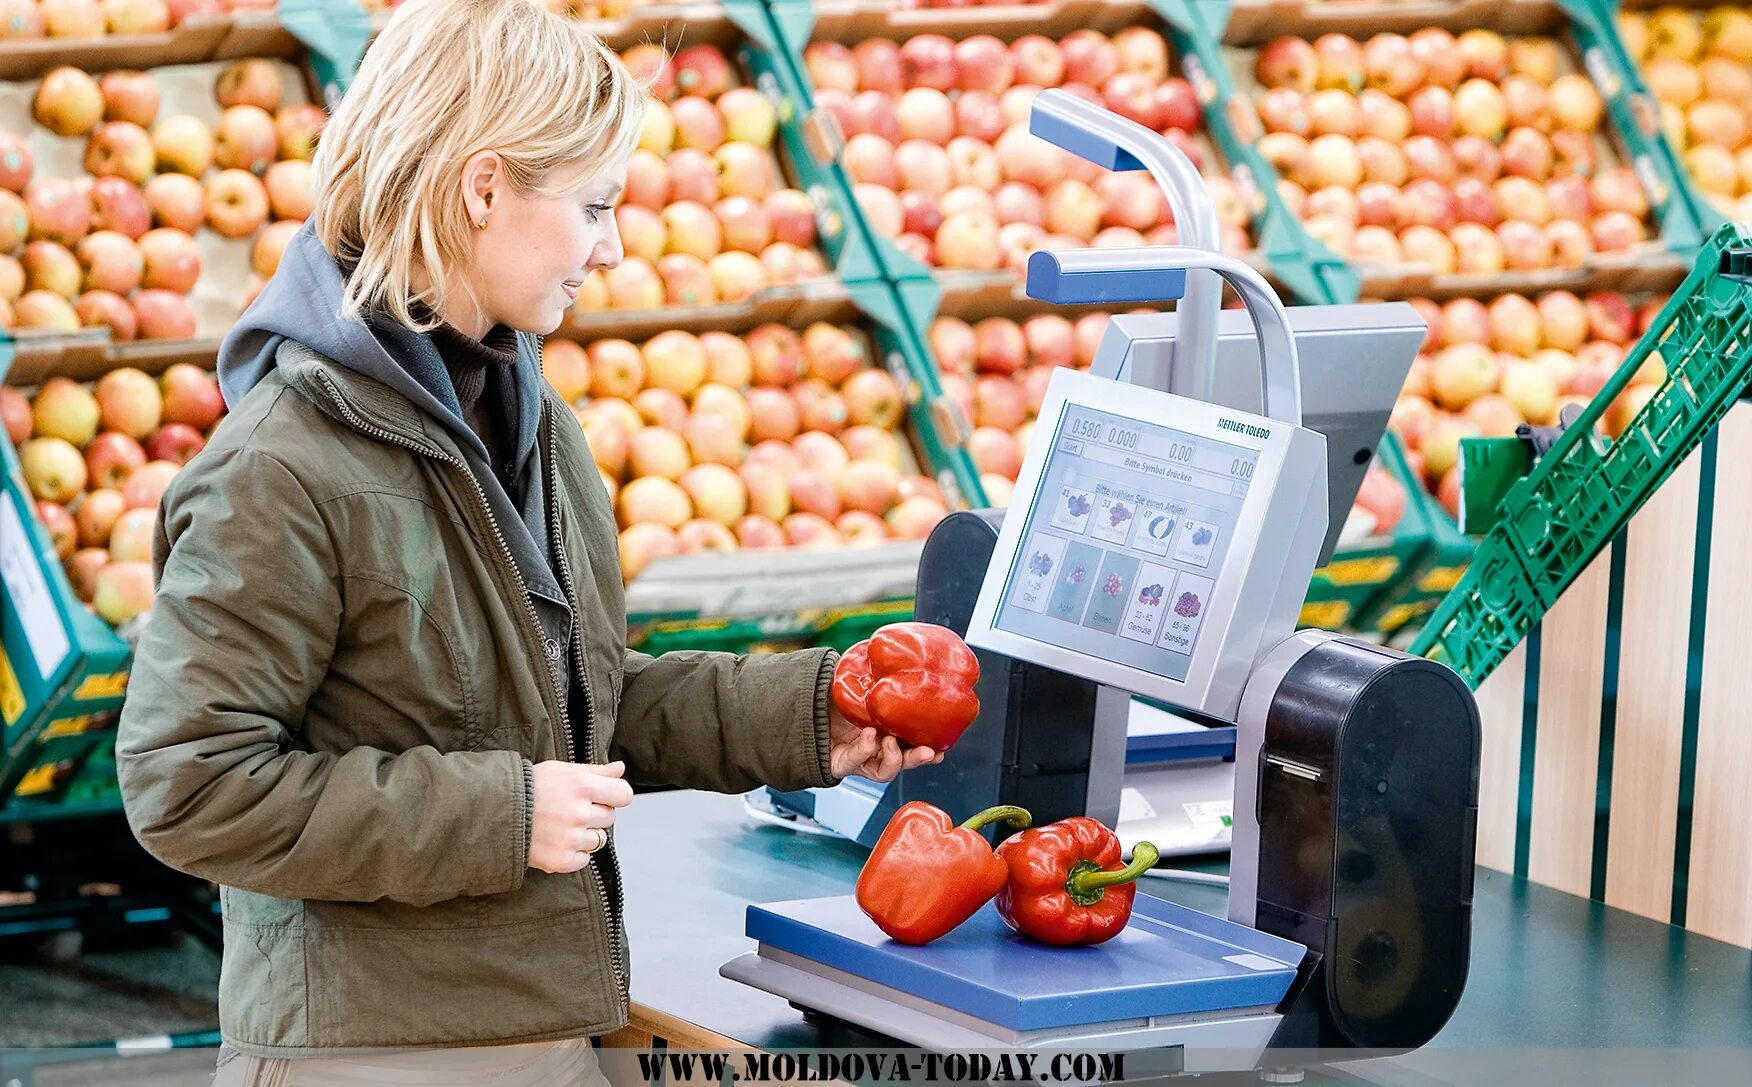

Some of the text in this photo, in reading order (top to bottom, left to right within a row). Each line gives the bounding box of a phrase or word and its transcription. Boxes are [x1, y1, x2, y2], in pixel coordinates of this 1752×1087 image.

[1072, 418, 1101, 439] 0.580
[1108, 427, 1137, 448] 0.000
[1217, 418, 1270, 439] METTLER TOLEDO
[1063, 441, 1078, 452] Start
[1169, 443, 1192, 462] 0.00
[1124, 458, 1140, 469] Bitte
[1141, 462, 1165, 477] Symbol
[1230, 459, 1254, 478] 0.00
[1062, 488, 1070, 498] 41
[1096, 484, 1110, 495] Bitte
[1134, 494, 1146, 505] Sie
[1146, 499, 1164, 510] einen
[1102, 499, 1111, 509] 33
[1143, 510, 1152, 519] 47
[1184, 521, 1194, 531] 43
[1163, 631, 1189, 646] Sonstige
